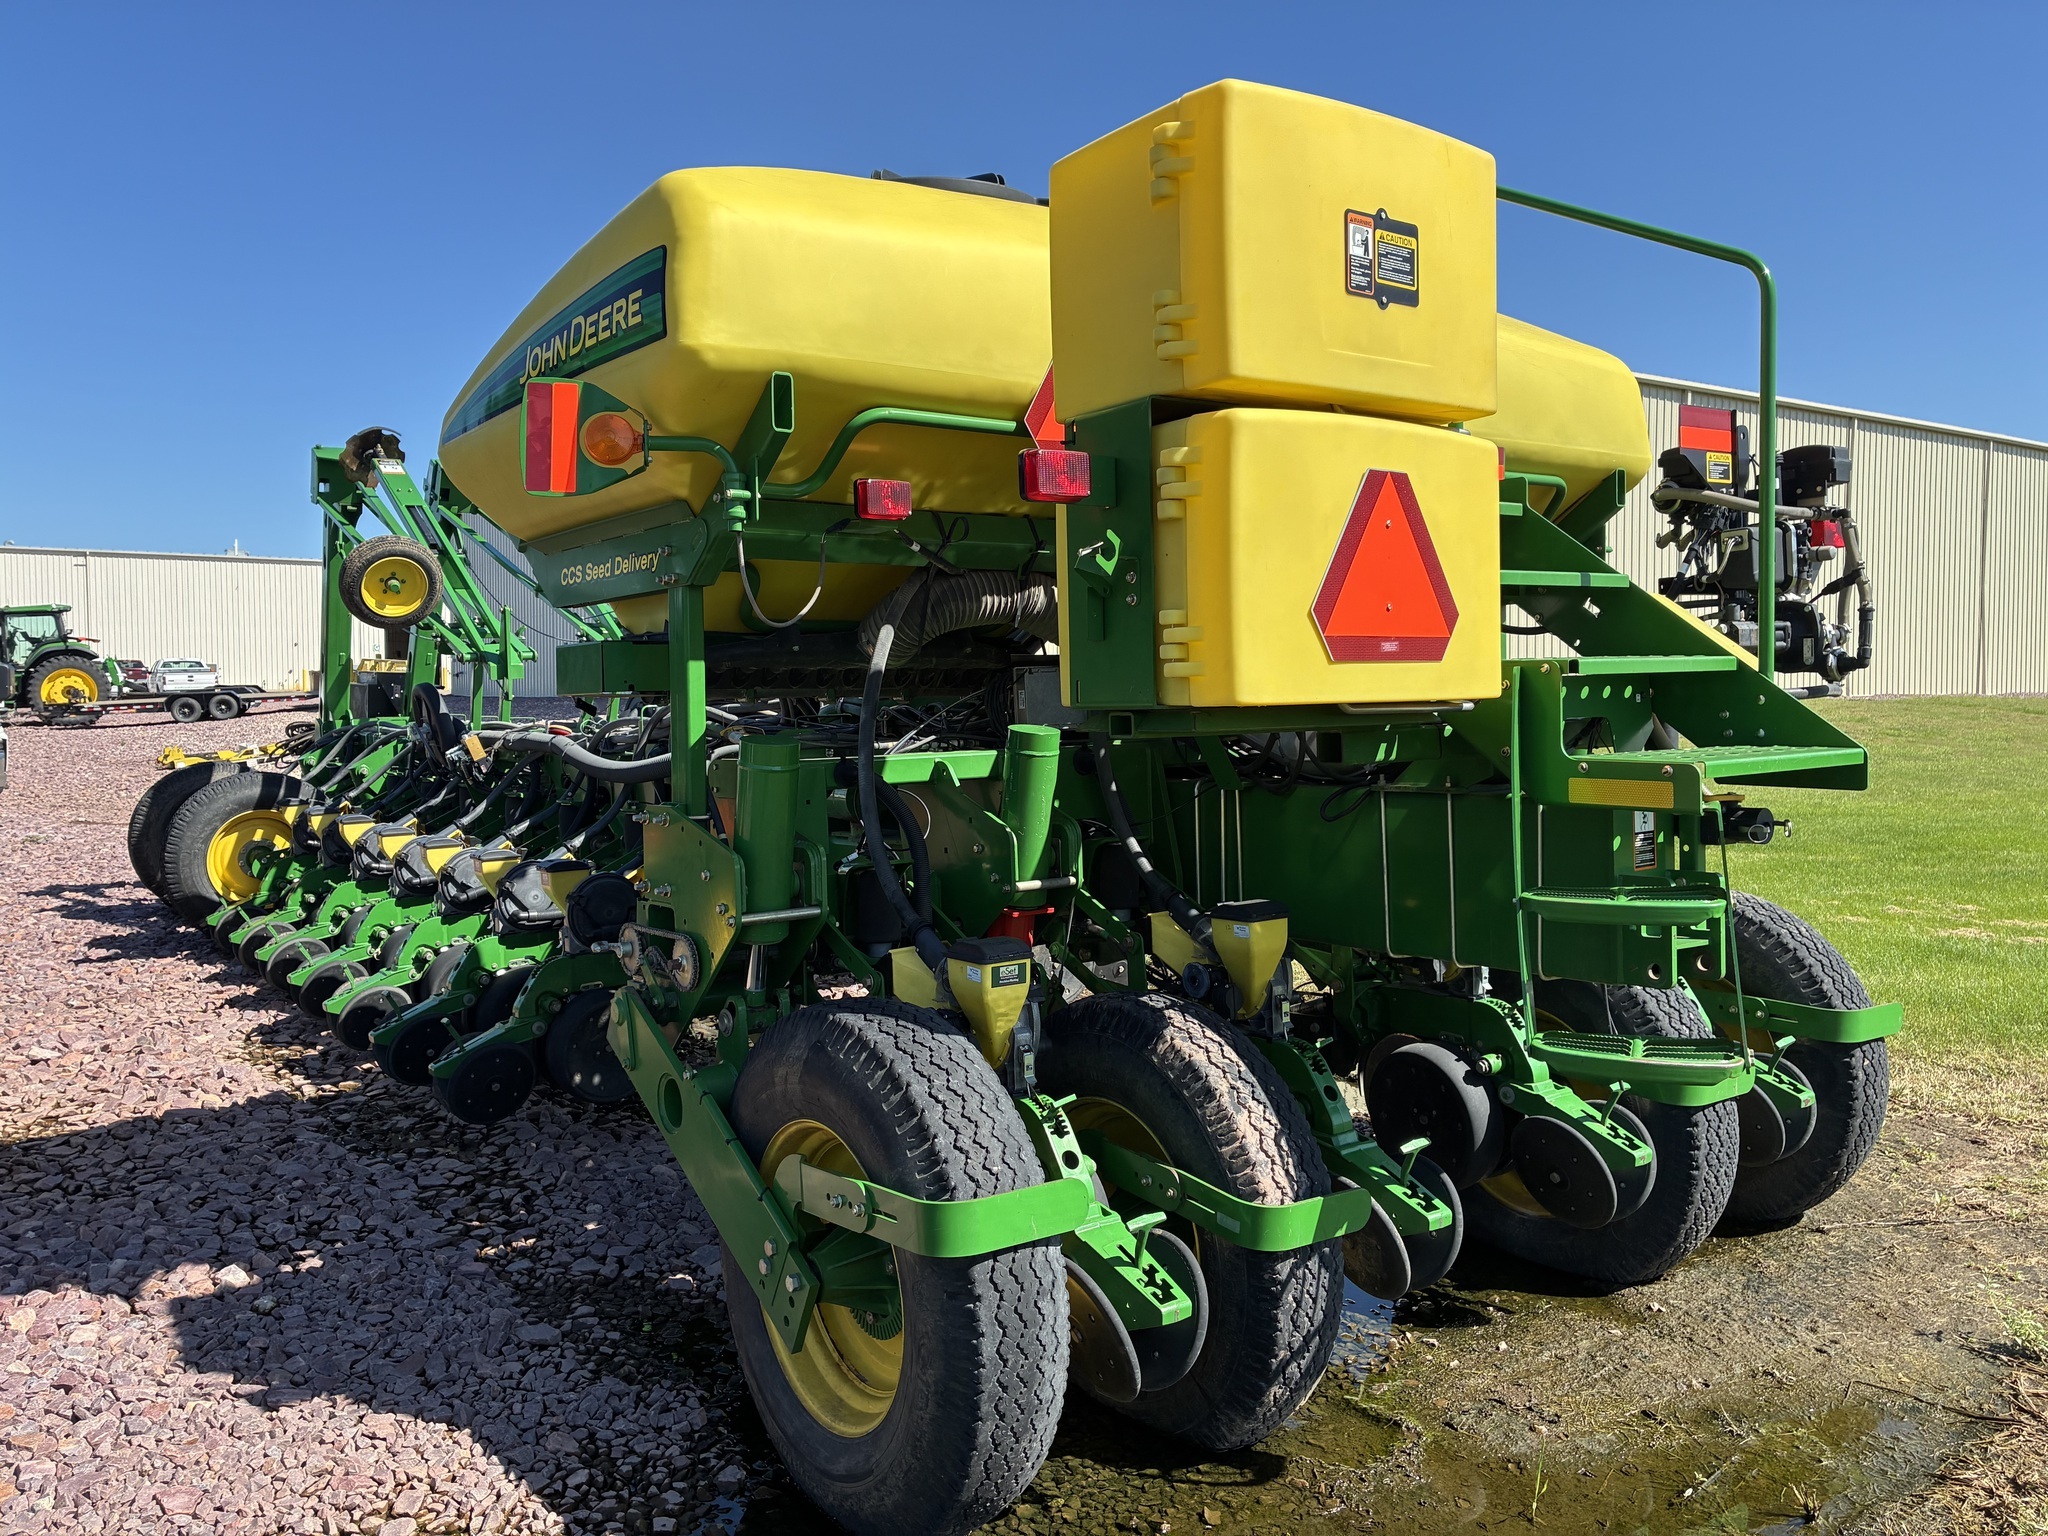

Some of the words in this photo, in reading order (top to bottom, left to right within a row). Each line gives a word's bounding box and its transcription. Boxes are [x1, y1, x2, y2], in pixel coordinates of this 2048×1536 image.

[1386, 234, 1413, 247] CAUTION
[520, 330, 568, 385] JOHN
[569, 289, 643, 356] DEERE
[560, 565, 583, 586] CCS
[585, 559, 612, 582] Seed
[614, 552, 660, 576] Delivery
